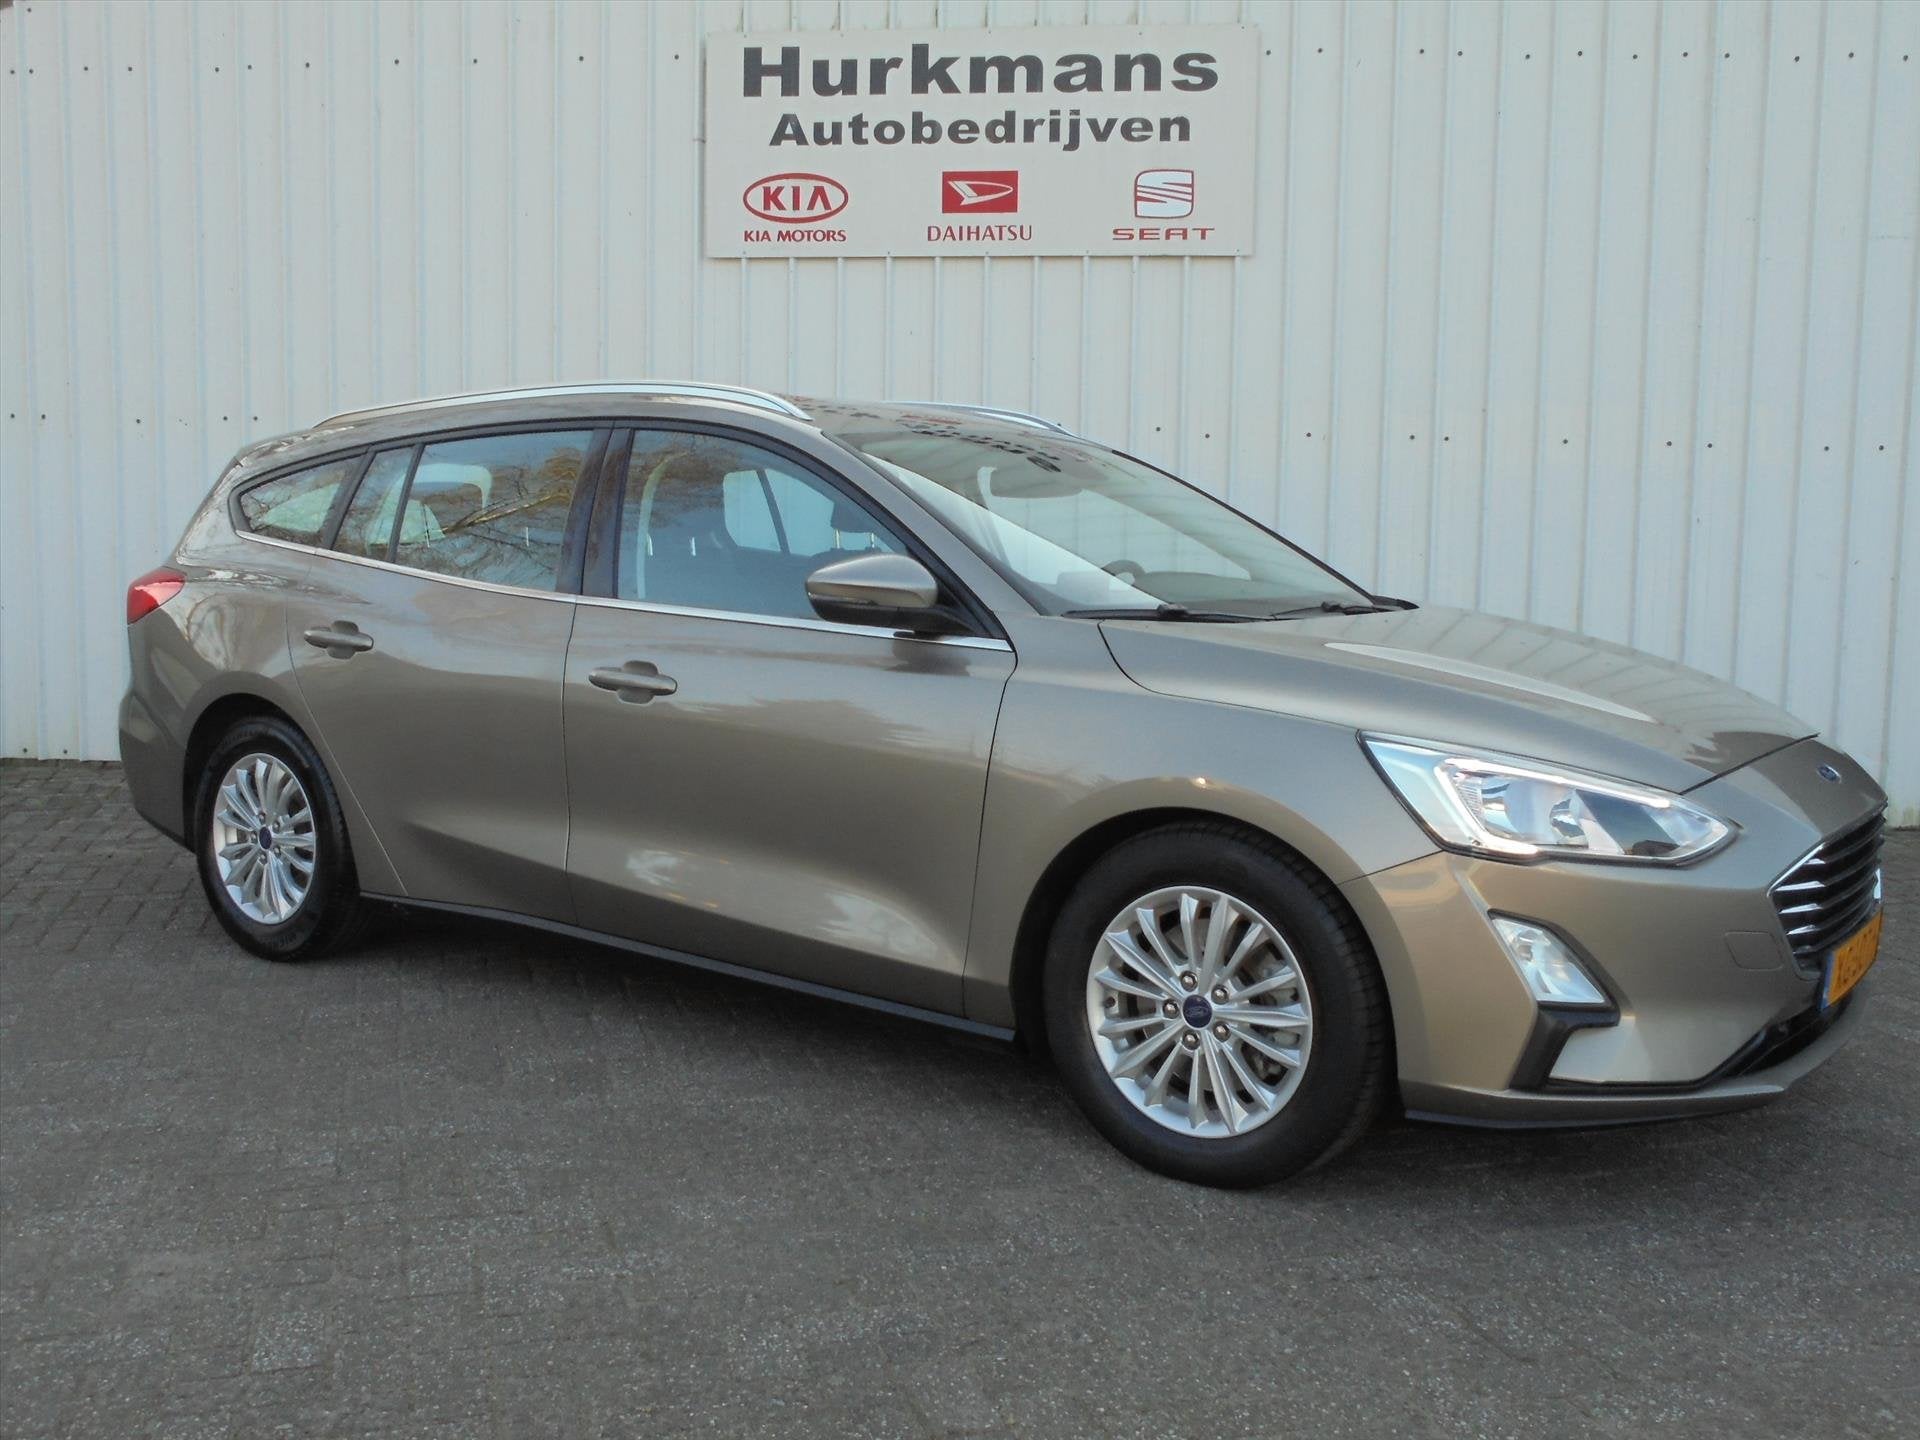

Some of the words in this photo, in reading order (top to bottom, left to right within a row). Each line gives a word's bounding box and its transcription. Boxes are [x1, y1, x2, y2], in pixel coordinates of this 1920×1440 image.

[743, 44, 1219, 97] Hurkmans
[769, 110, 1191, 151] Autobedrijven
[762, 185, 832, 211] KIA
[744, 230, 772, 242] KIA
[777, 229, 847, 242] MOTORS
[927, 224, 1032, 242] DAIHATSU
[1112, 227, 1215, 241] SEAT
